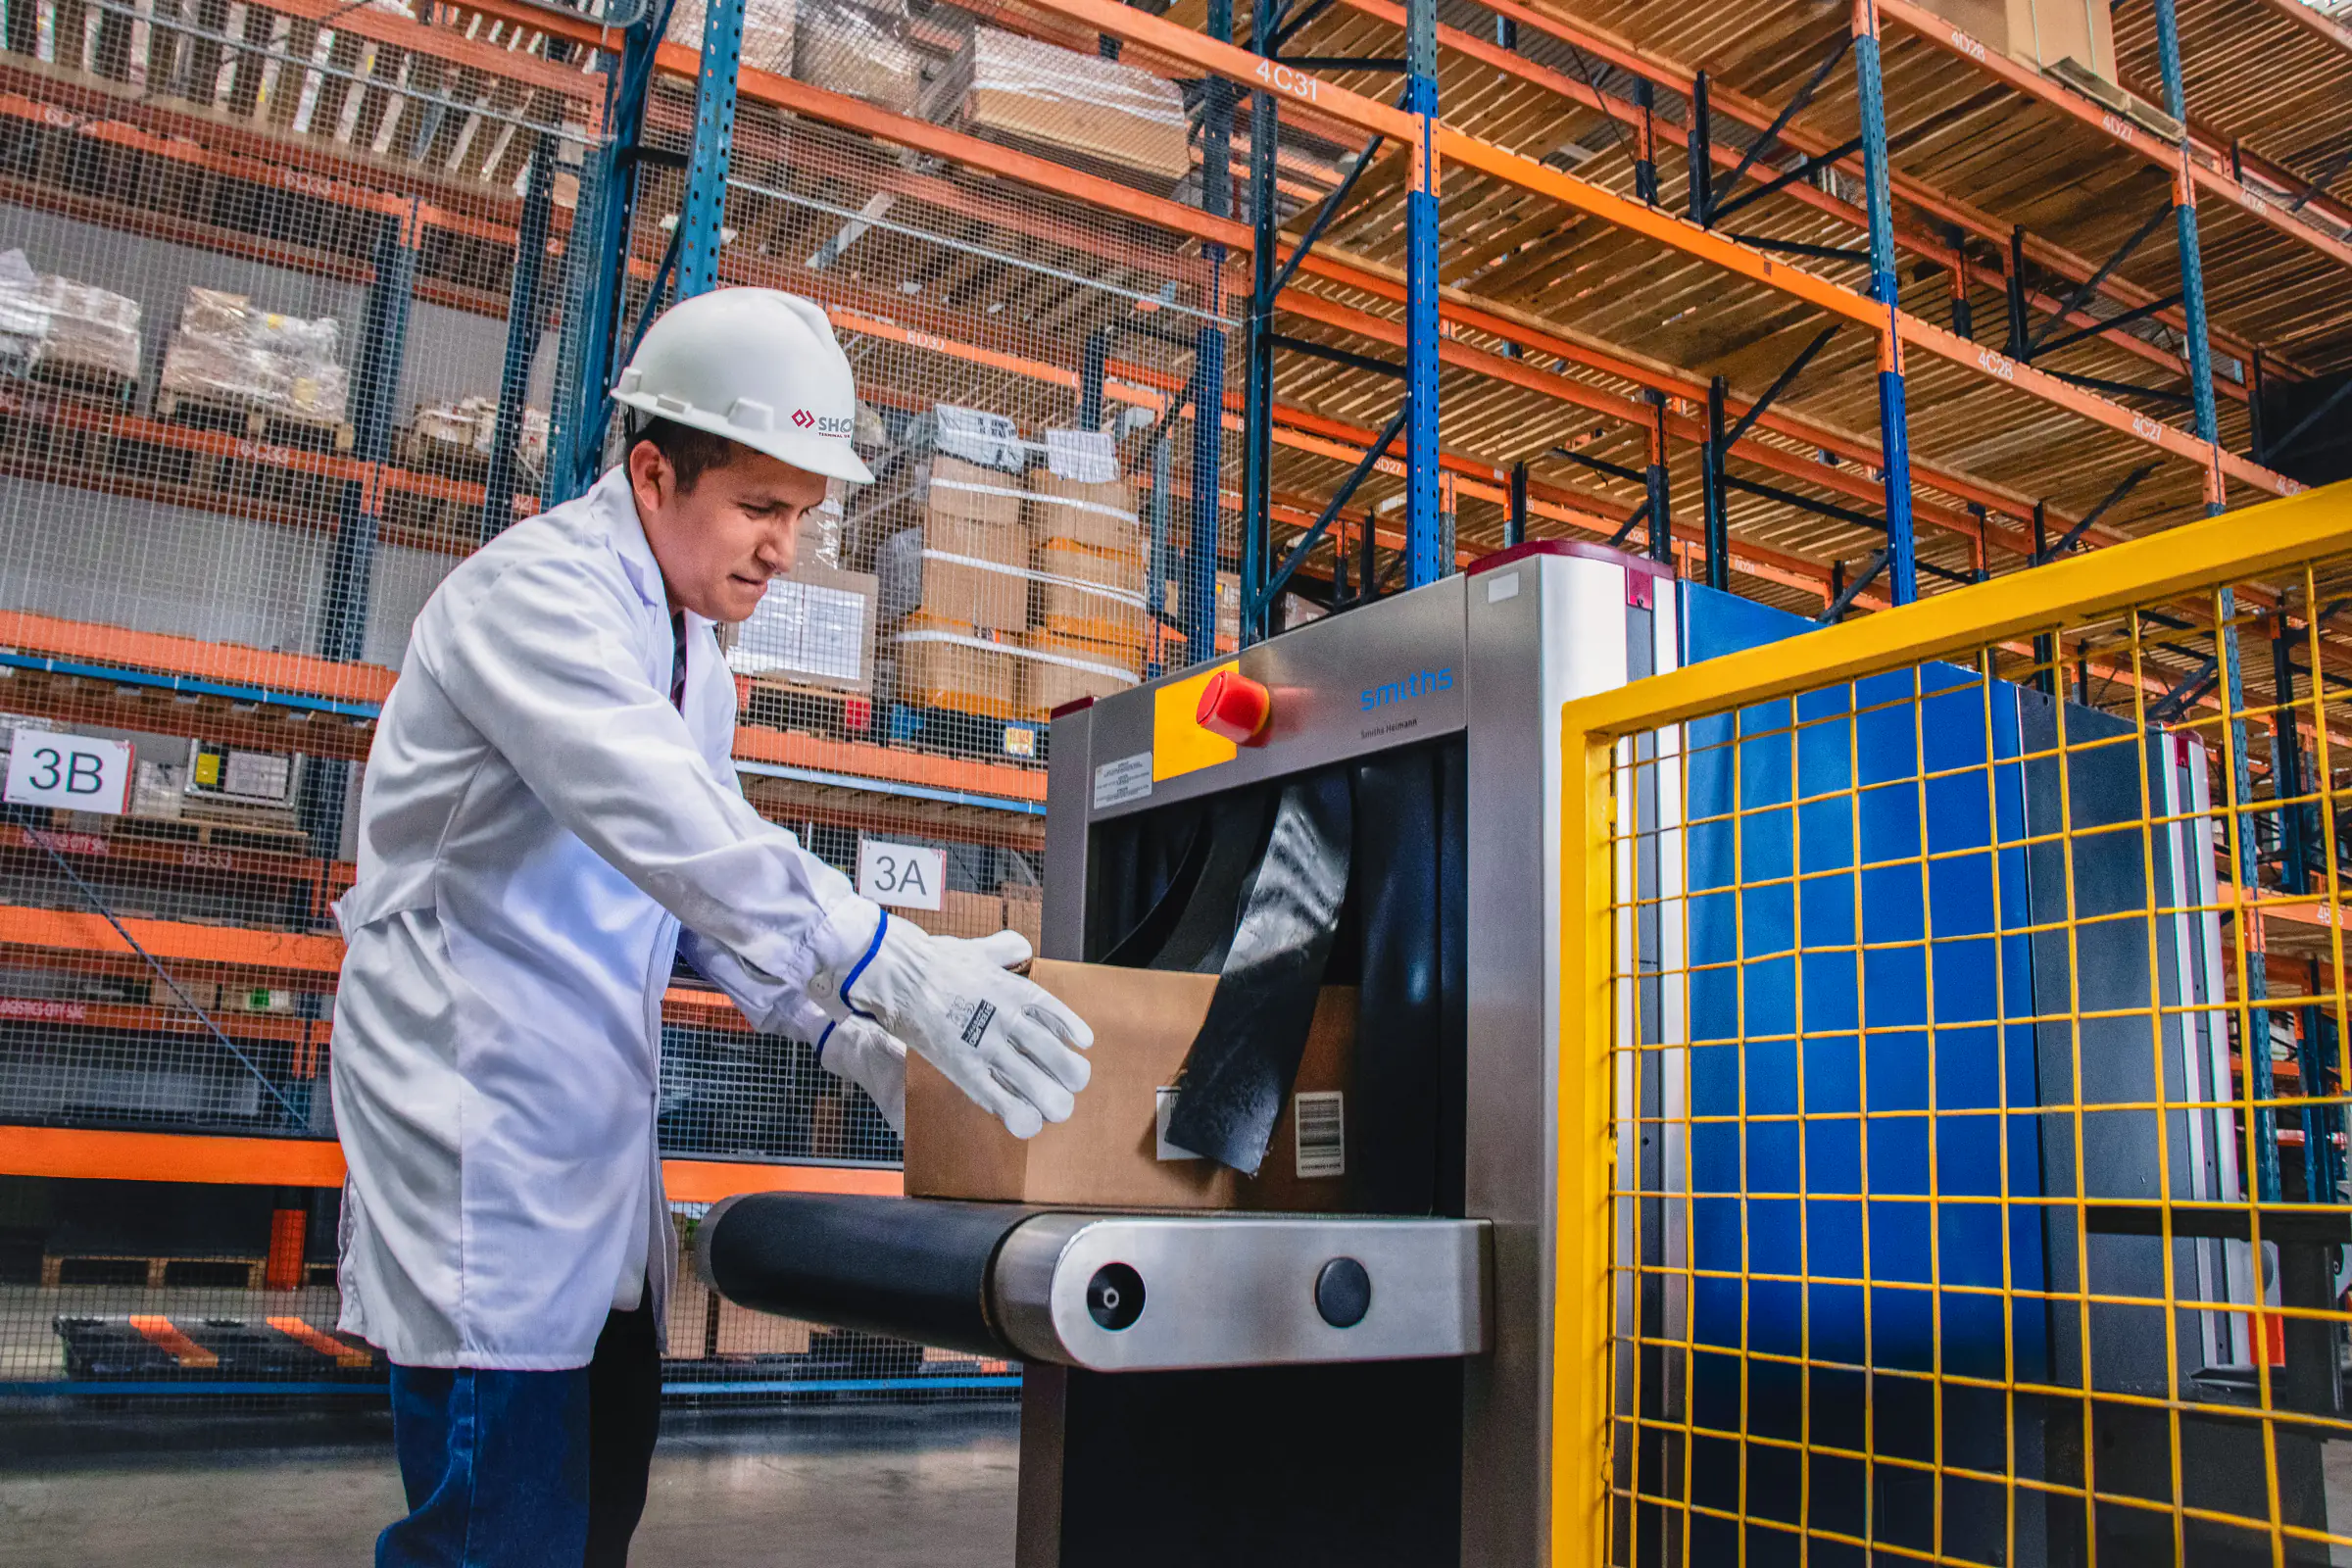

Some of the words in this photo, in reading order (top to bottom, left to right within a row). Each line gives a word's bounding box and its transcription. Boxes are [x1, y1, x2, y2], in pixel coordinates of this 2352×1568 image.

[1255, 59, 1317, 102] 4C31
[1978, 351, 2013, 381] 4C28
[2132, 416, 2162, 442] 4C27
[1360, 667, 1453, 711] smiths
[1361, 726, 1385, 740] Smiths
[1386, 718, 1418, 734] Heimann
[28, 748, 104, 795] 3B
[874, 856, 927, 896] 3A
